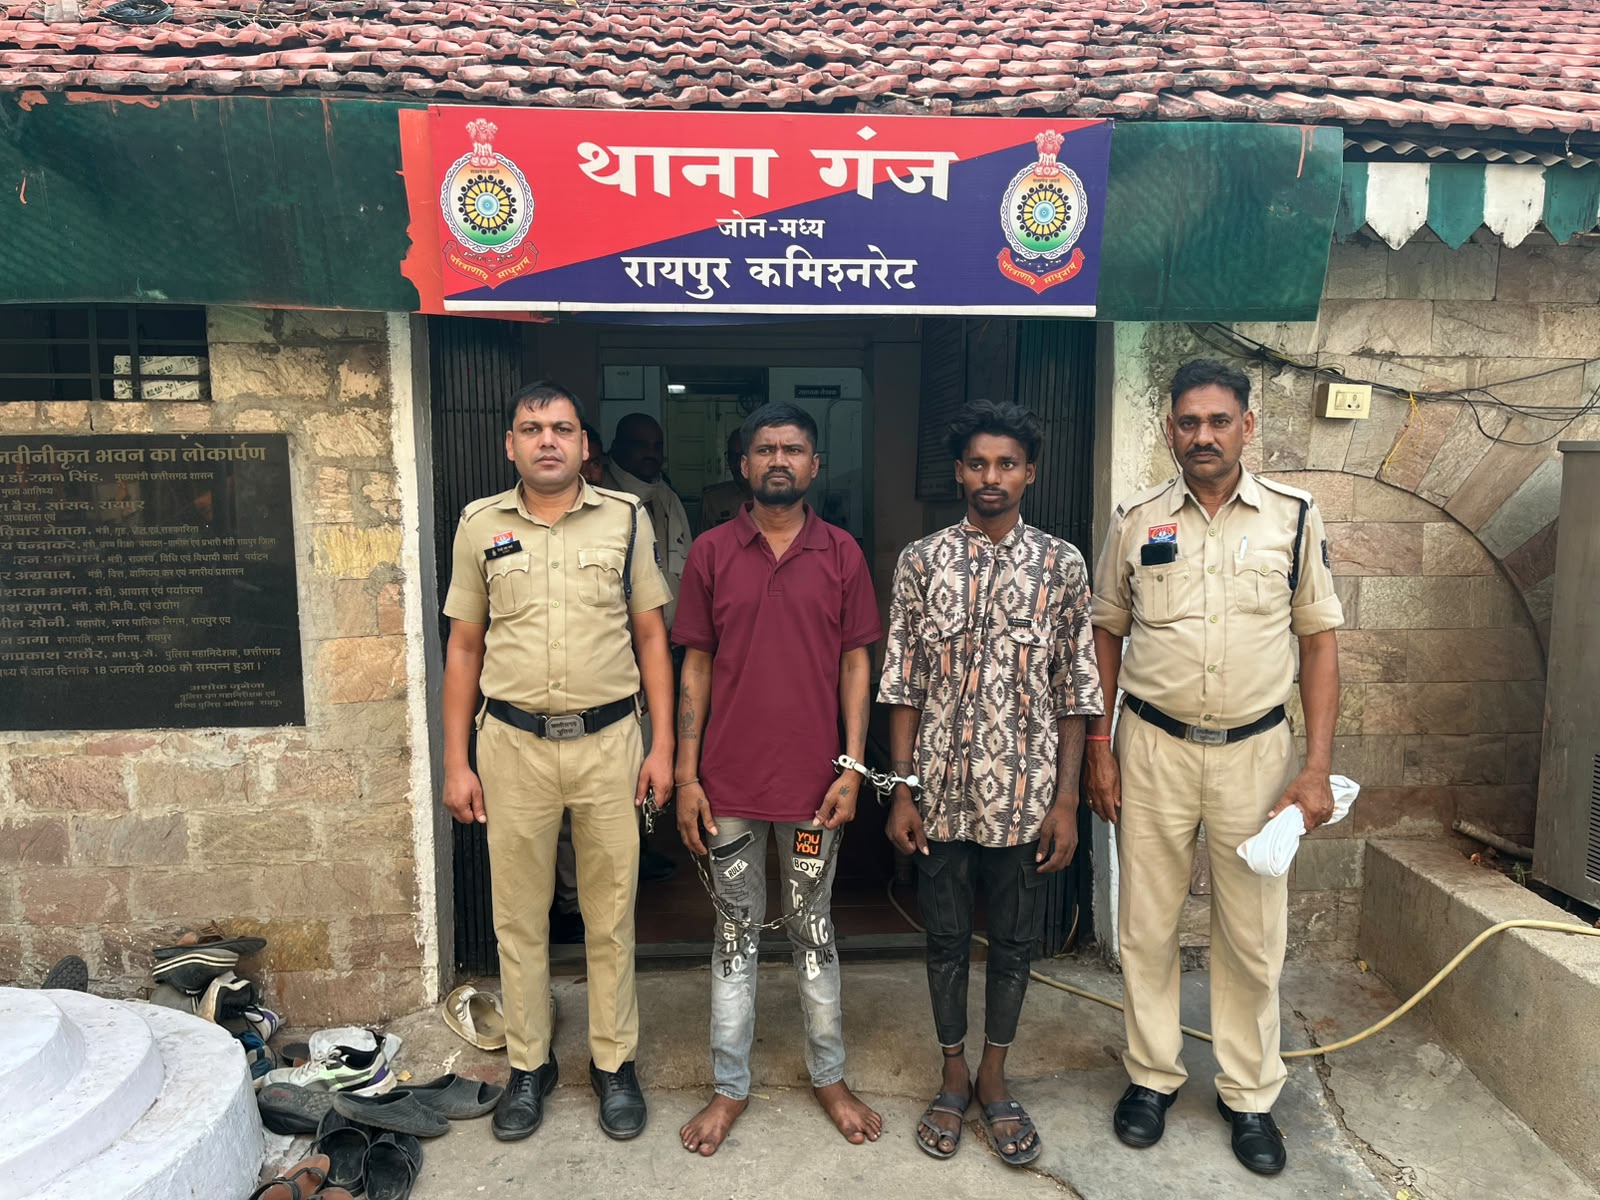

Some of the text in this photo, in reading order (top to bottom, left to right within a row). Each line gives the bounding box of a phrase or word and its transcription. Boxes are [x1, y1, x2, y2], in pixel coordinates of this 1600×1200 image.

[577, 126, 960, 201] थाना गंज
[716, 209, 826, 239] जोन-मध्य
[620, 256, 732, 300] रायपुर
[96, 448, 144, 463] भवन
[150, 447, 176, 462] का
[182, 442, 266, 462] लोकार्पण
[31, 666, 55, 677] आज
[94, 666, 107, 675] 18
[109, 662, 145, 675] जनवरी
[148, 664, 177, 674] 2006
[179, 661, 193, 673] को
[196, 662, 230, 673] सम्पन्न
[797, 831, 821, 844] YOU
[796, 843, 819, 855] YOU
